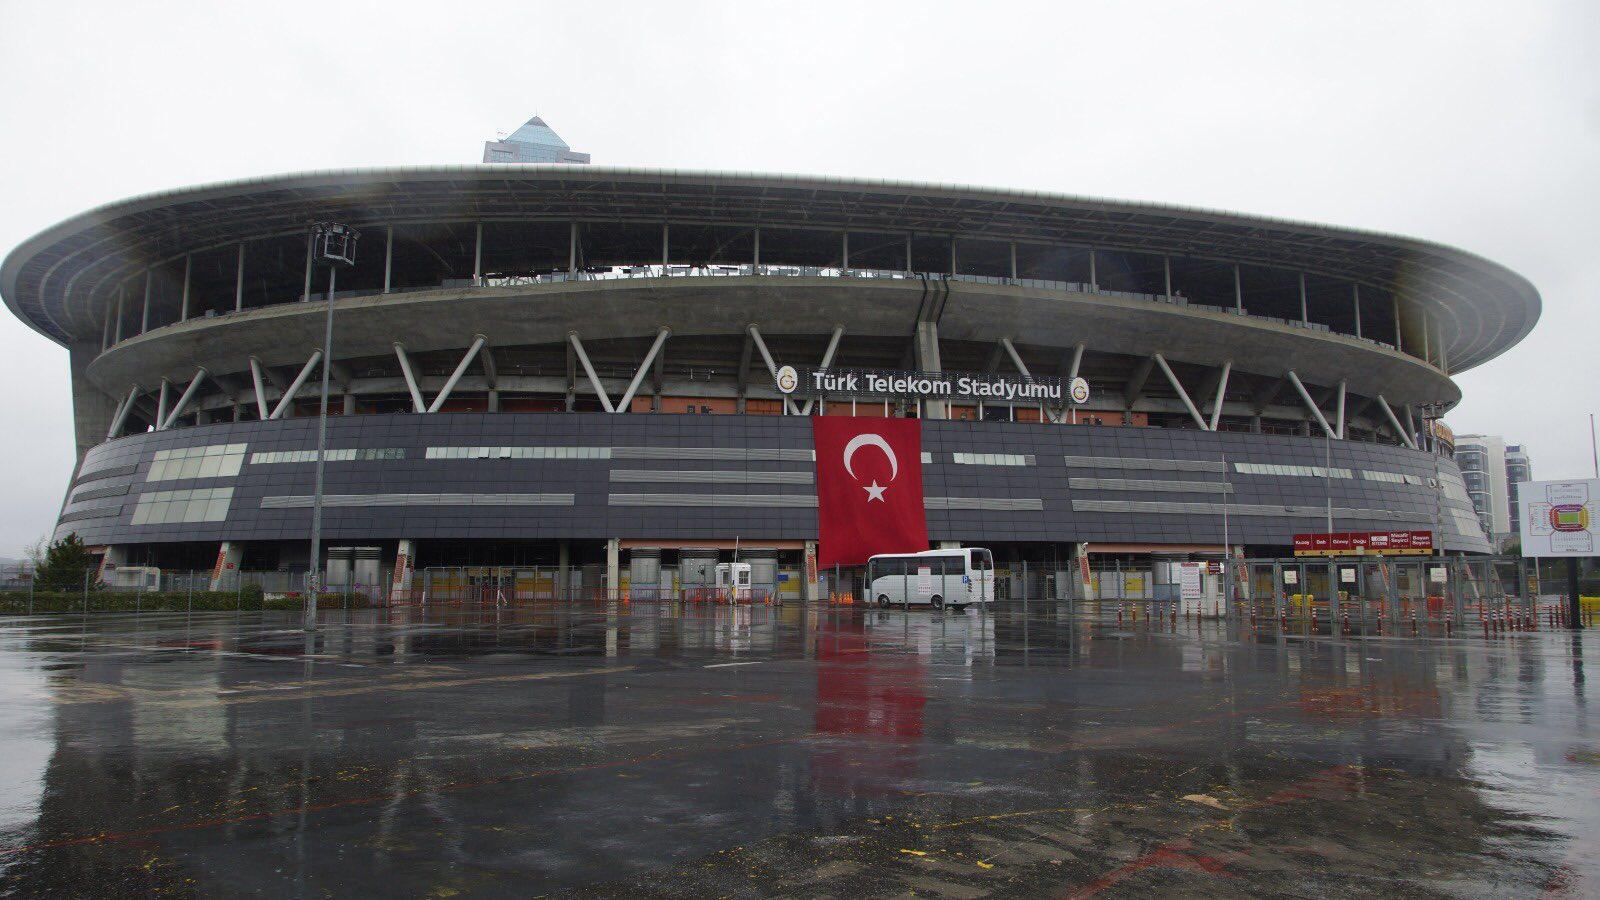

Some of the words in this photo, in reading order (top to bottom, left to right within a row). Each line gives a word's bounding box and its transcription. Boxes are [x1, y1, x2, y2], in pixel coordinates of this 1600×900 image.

[812, 372, 858, 391] Türk
[865, 374, 951, 394] Telekom
[958, 377, 1061, 400] Stadyumu
